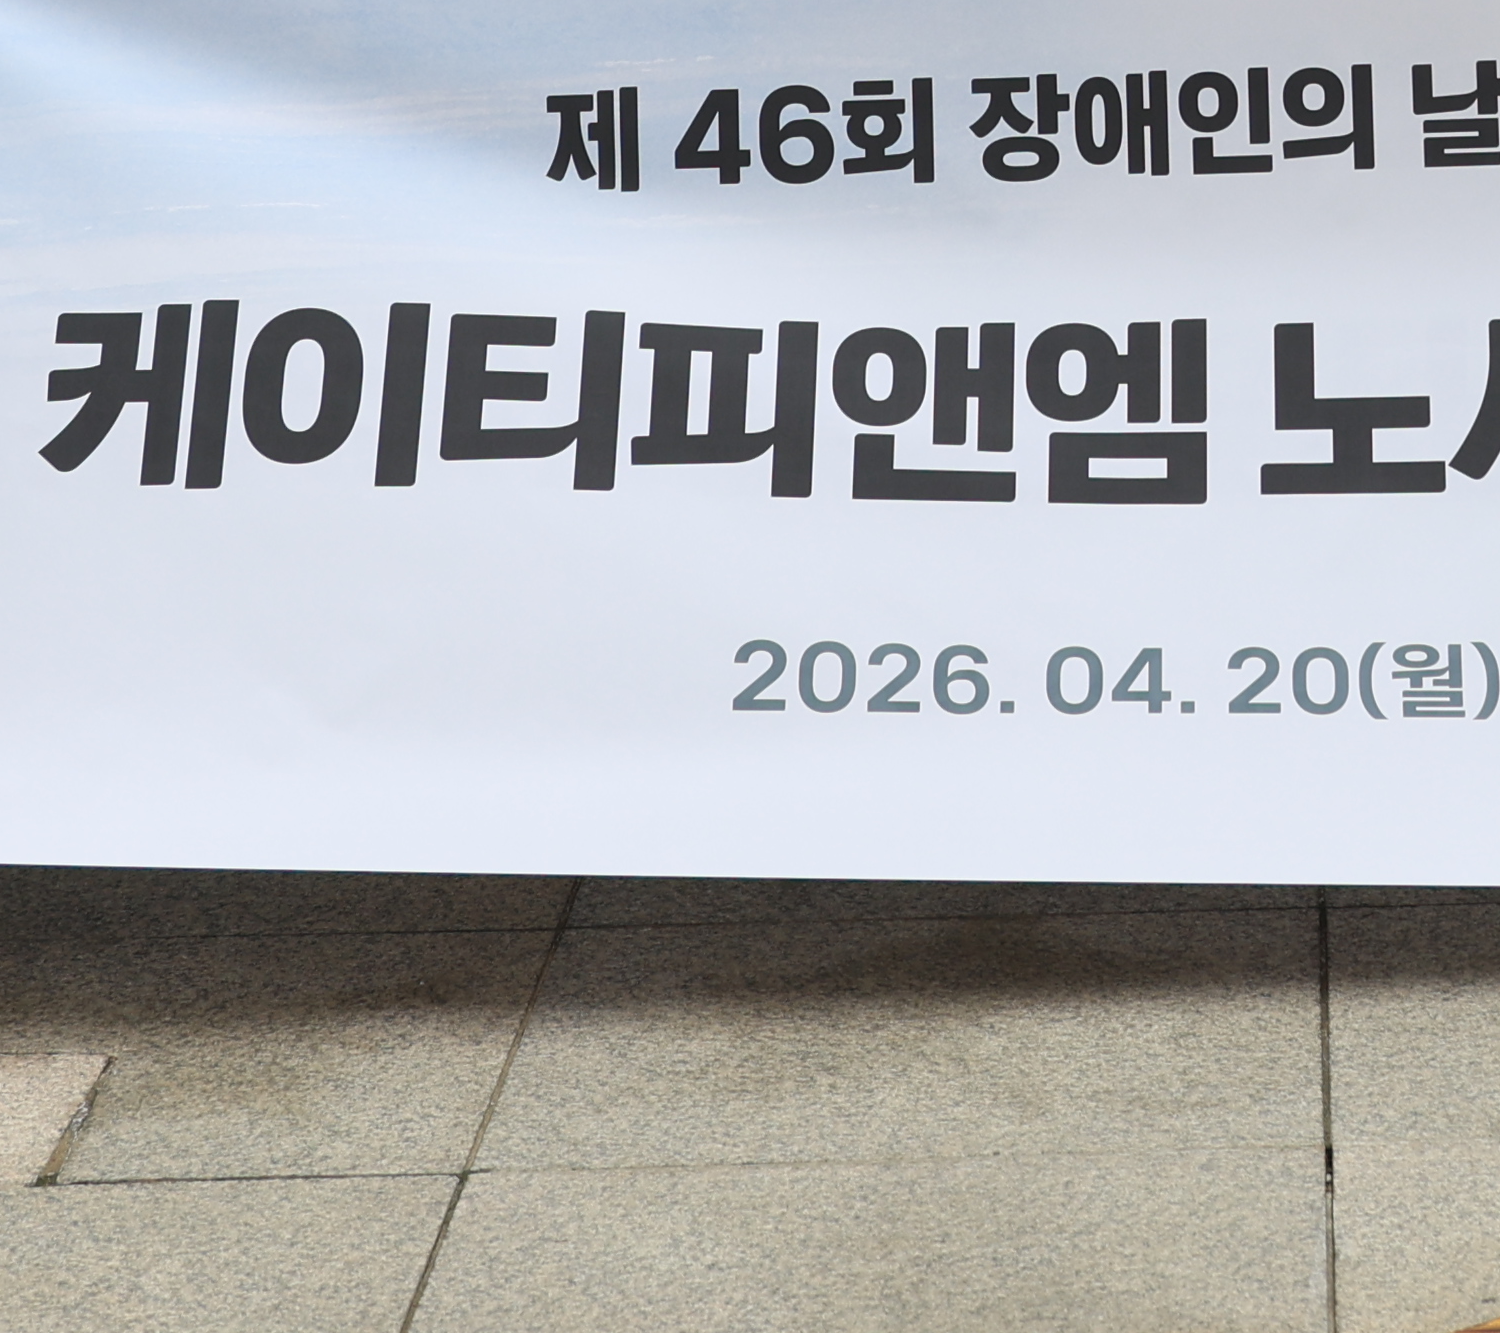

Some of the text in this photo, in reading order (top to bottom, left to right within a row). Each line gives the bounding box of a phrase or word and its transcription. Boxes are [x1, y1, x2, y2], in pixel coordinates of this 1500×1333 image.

[546, 85, 640, 193] 제
[673, 74, 935, 187] 46회
[966, 62, 1375, 183] 장애인의
[38, 298, 1209, 505] 케이티피앤엠
[731, 638, 1500, 720] 2026. 04. 20(월)
